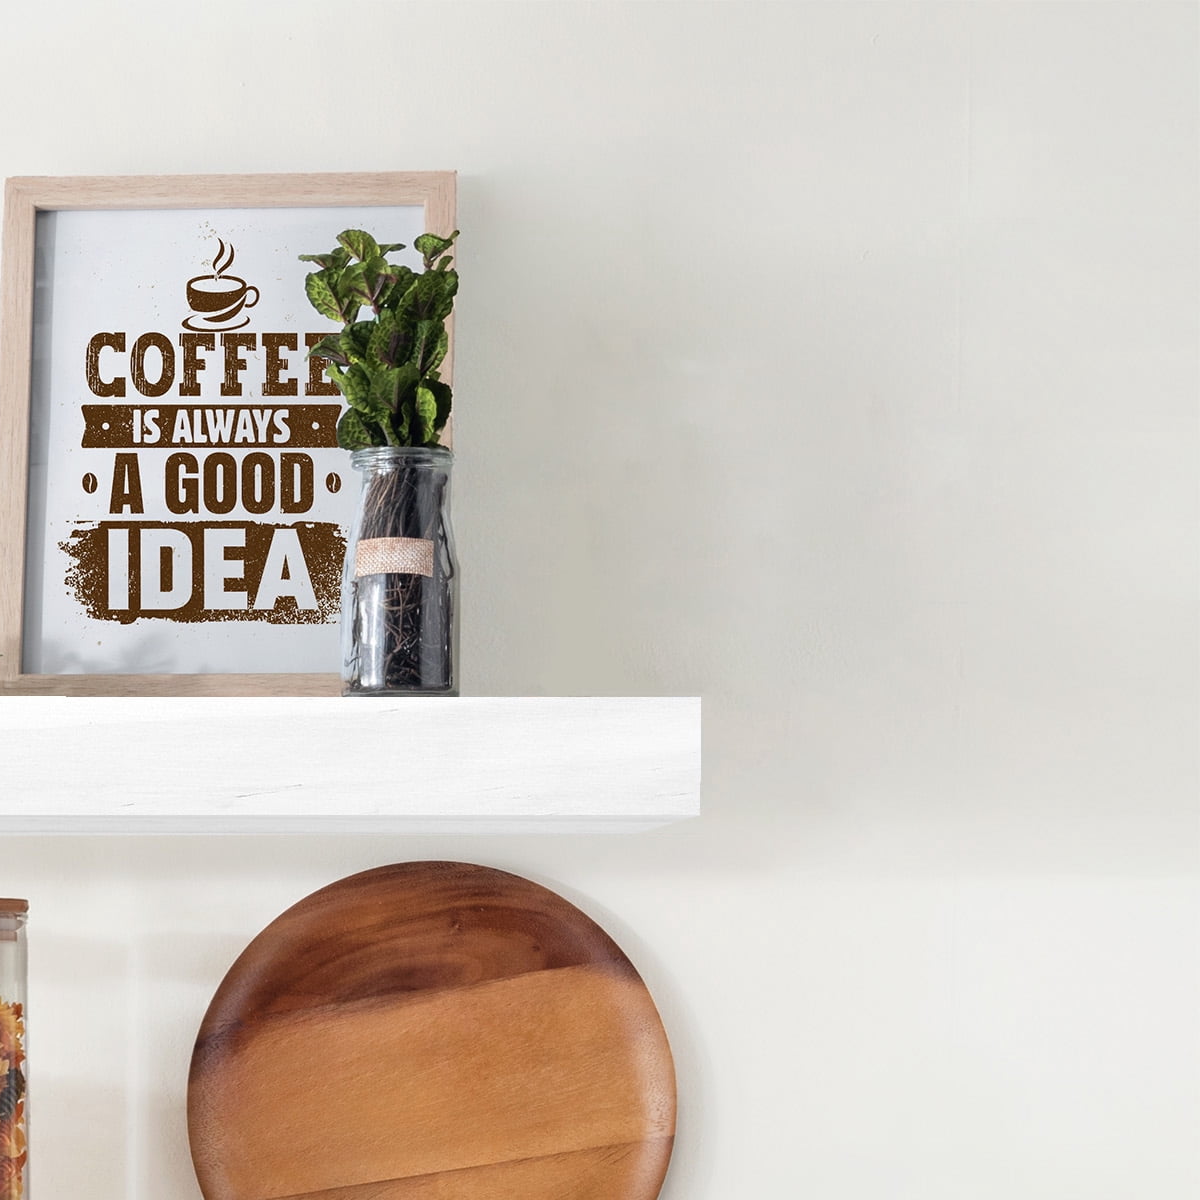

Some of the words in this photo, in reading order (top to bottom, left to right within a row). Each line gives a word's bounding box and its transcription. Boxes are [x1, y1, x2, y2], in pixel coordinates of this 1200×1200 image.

[86, 332, 342, 397] COFFEE
[133, 409, 160, 443] IS
[173, 409, 291, 443] ALWAYS
[109, 452, 144, 514] A
[165, 452, 314, 514] GOOD
[107, 528, 317, 610] IDEA
